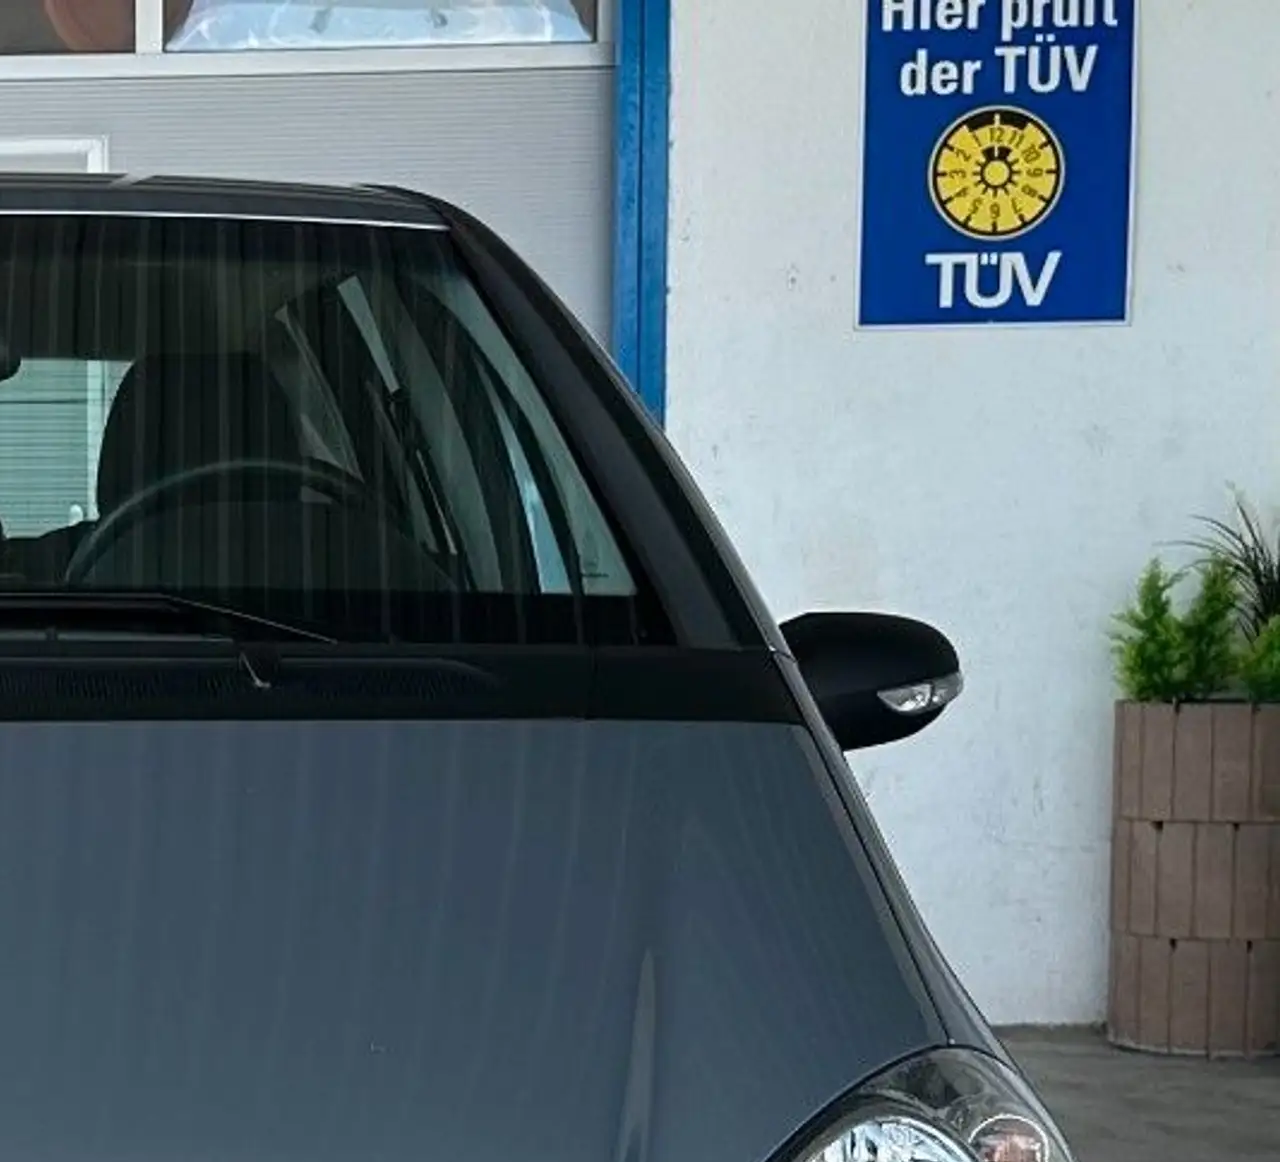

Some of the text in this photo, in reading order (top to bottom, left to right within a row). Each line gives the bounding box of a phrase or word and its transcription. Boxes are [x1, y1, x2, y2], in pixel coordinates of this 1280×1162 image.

[881, 0, 985, 31] Hier
[900, 34, 1098, 96] der TÜV
[989, 127, 1005, 143] 12
[954, 147, 972, 162] 2
[949, 168, 967, 179] 3
[989, 202, 1001, 220] 6
[925, 250, 1062, 309] TÜV
